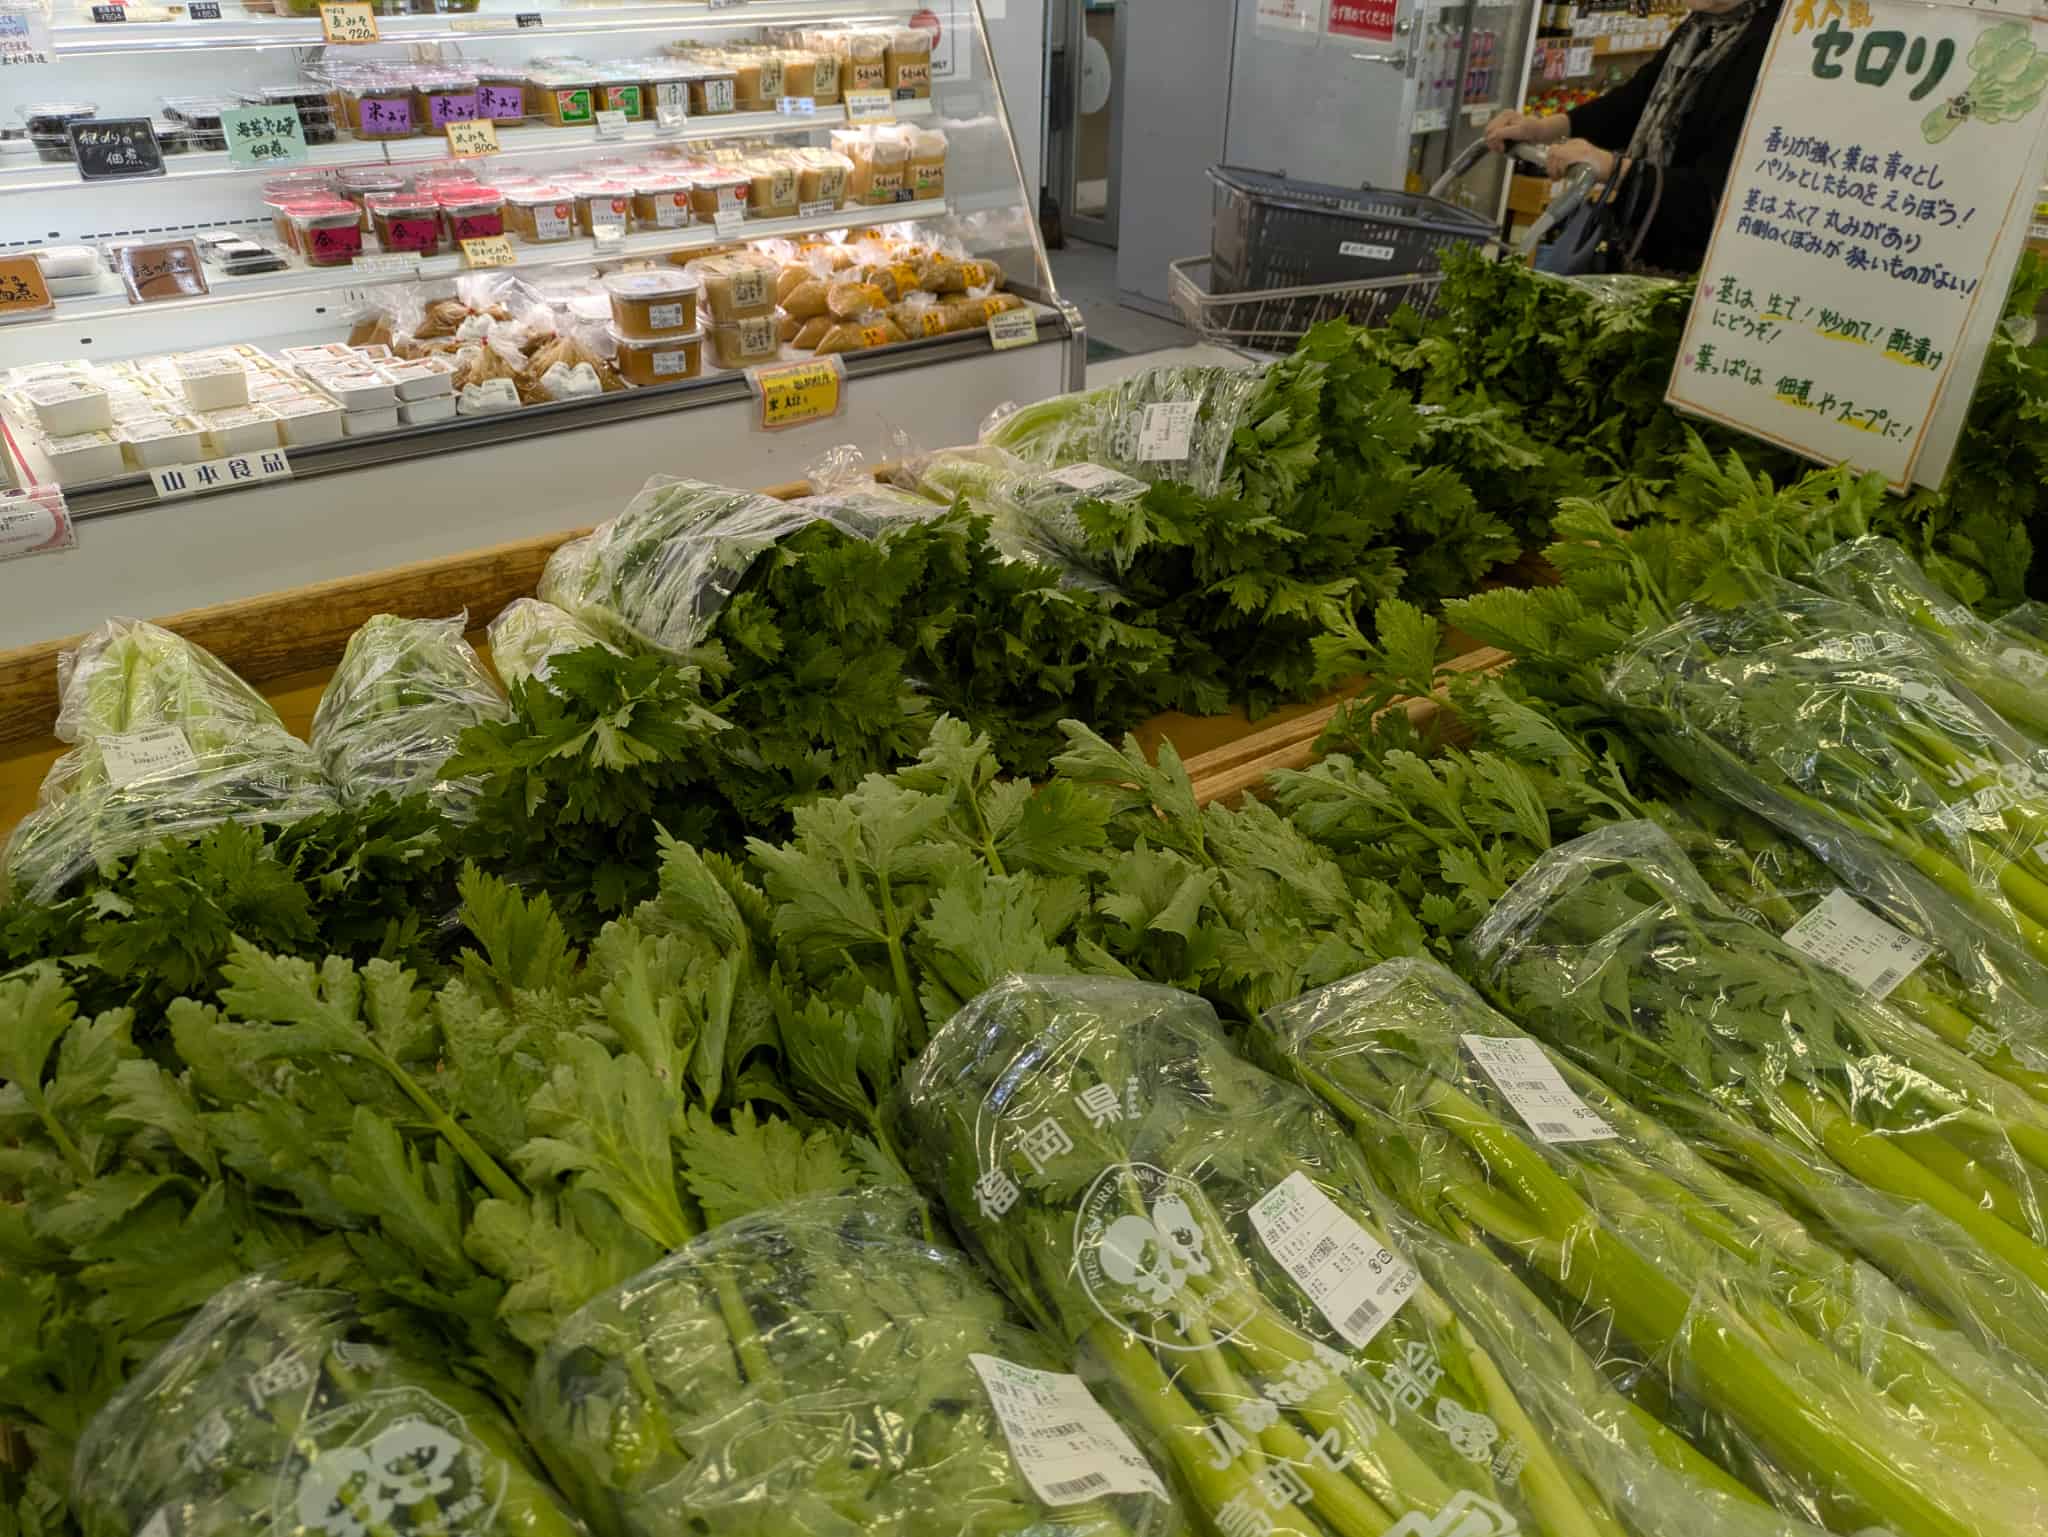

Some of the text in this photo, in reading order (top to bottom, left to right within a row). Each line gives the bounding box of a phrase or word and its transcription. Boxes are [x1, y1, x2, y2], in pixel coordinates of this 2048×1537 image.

[1812, 19, 1955, 101] セロリ
[1742, 188, 1921, 253] 茎は太くて丸みがあり
[160, 452, 285, 492] 山本食品
[972, 1081, 1124, 1223] 福岡県
